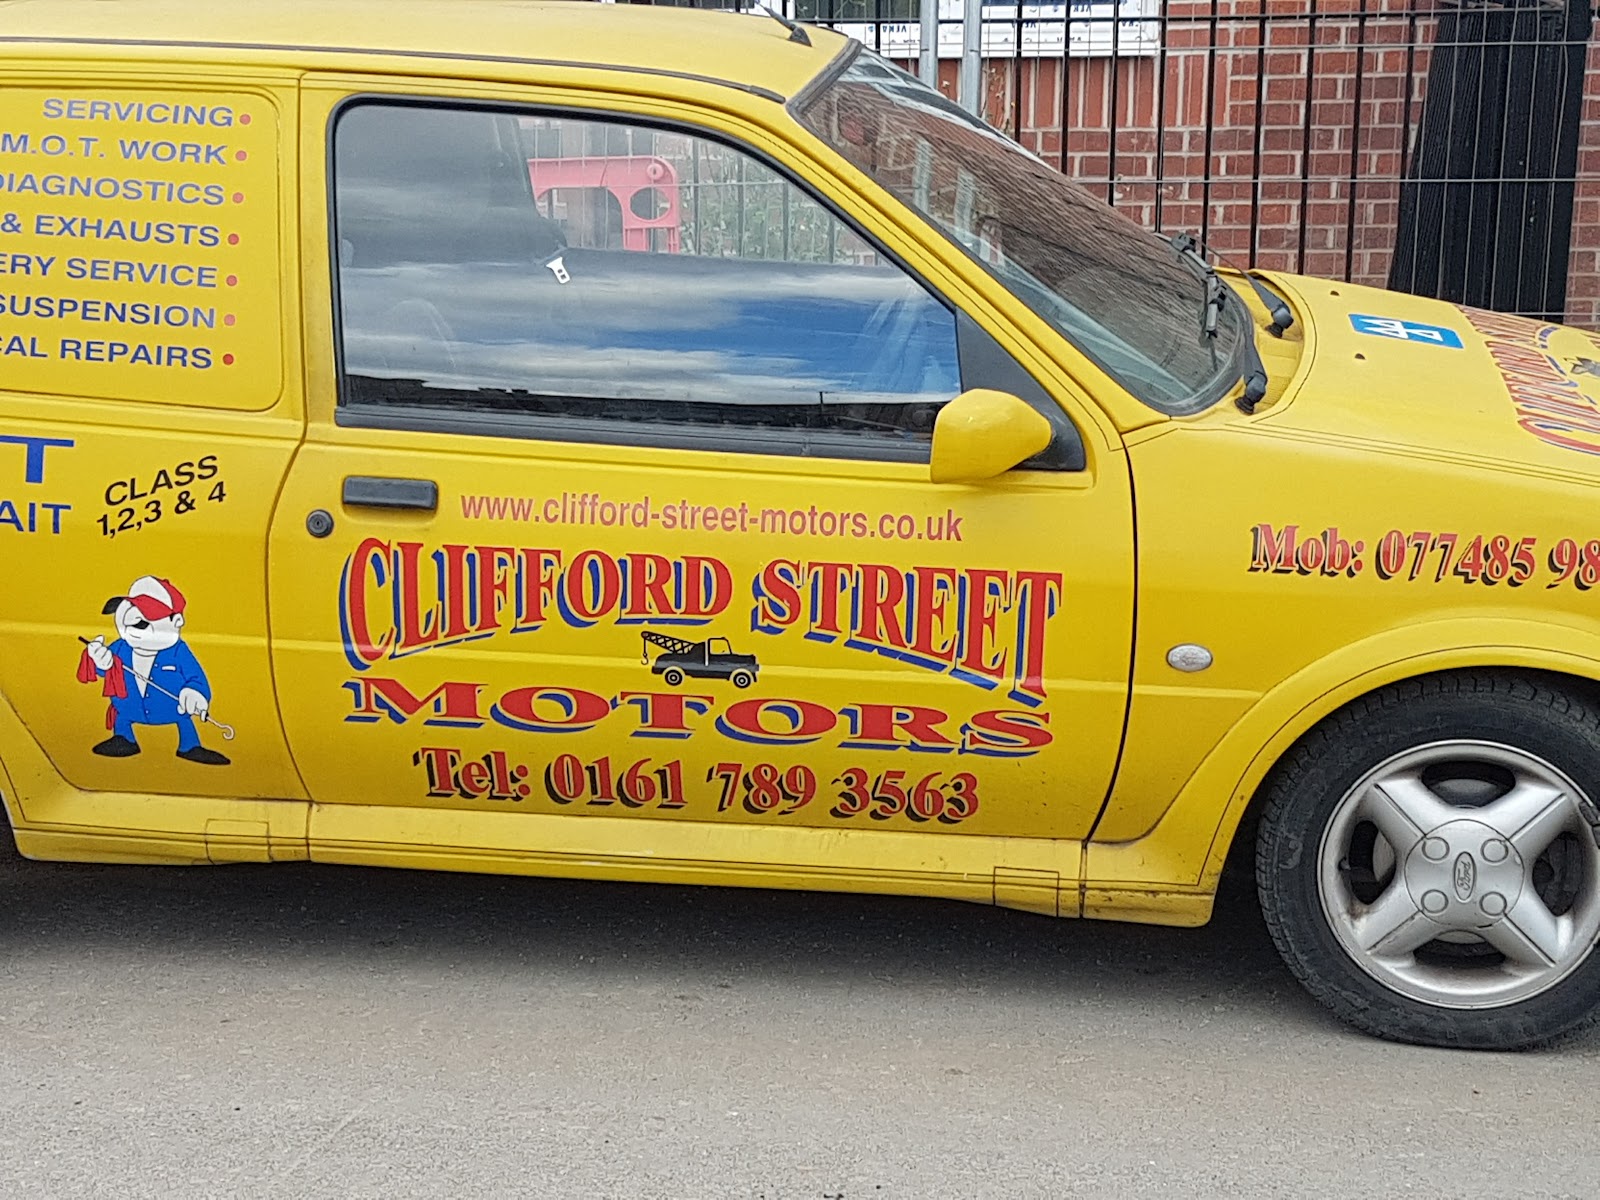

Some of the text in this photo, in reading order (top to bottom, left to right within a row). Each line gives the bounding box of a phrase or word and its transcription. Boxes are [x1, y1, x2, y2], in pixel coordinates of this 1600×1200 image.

[43, 98, 233, 127] SERVICING
[1, 133, 228, 165] M.O.T. WORK
[1, 212, 220, 247] & EXHAUSTS
[66, 257, 217, 288] SERVICE
[0, 335, 212, 369] AL REPAIRS
[104, 455, 219, 507] CLASS
[97, 481, 227, 539] 1,2,3 & 4
[460, 492, 964, 542] www.clifford-street-motors.co.uk
[1247, 523, 1366, 579] Mob:
[1375, 529, 1537, 588] 077485
[338, 536, 1063, 709] CLIFFORD STREET
[341, 676, 1053, 758] MOTORS
[413, 747, 979, 824] Tel: 0161 789 3563
[1456, 860, 1471, 891] Ford
